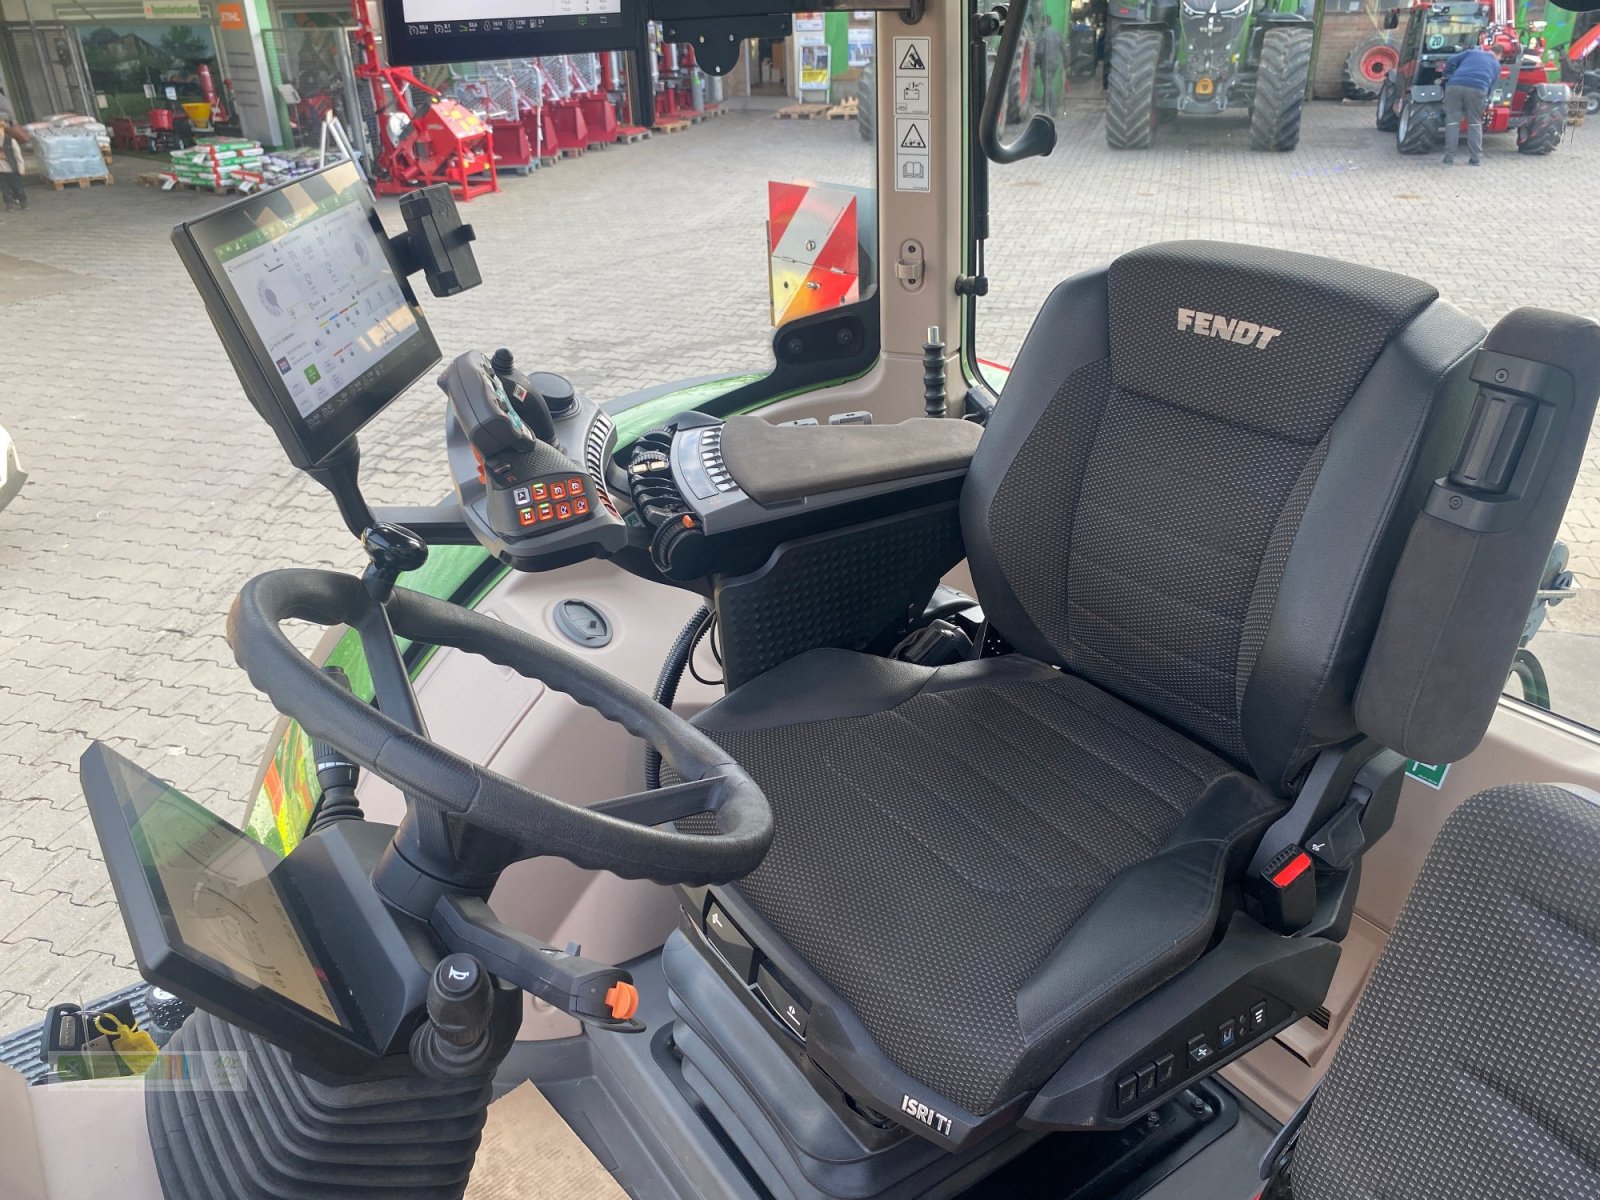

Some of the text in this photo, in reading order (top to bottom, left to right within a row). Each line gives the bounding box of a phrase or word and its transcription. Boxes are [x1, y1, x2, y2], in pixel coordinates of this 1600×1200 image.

[1432, 36, 1441, 47] 20
[1177, 307, 1283, 350] FENDT
[525, 512, 531, 520] N
[901, 1094, 952, 1136] ISRI Ti
